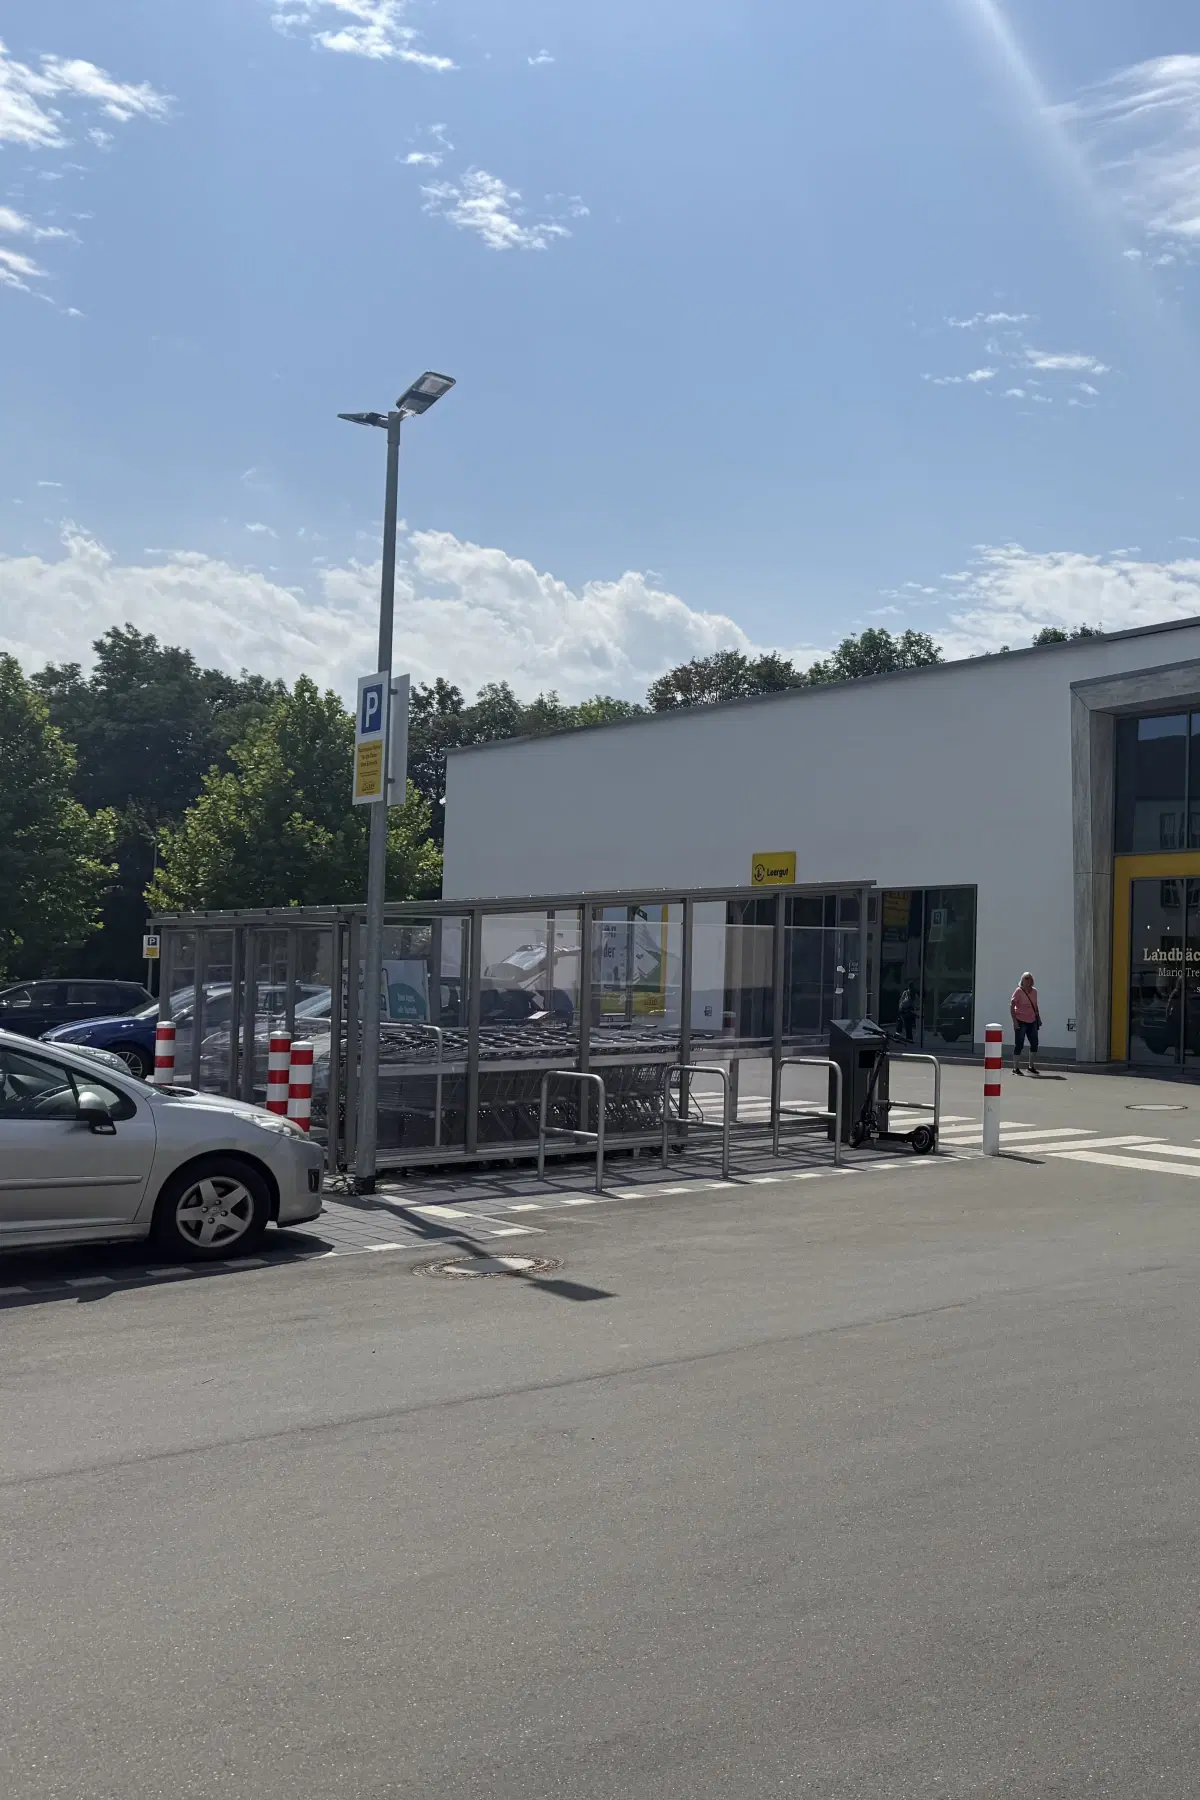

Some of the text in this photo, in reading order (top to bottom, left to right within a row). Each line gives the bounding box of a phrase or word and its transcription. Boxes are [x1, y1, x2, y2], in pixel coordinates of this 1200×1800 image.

[365, 691, 378, 728] P
[766, 867, 789, 878] Leergut
[1158, 967, 1184, 978] Mario
